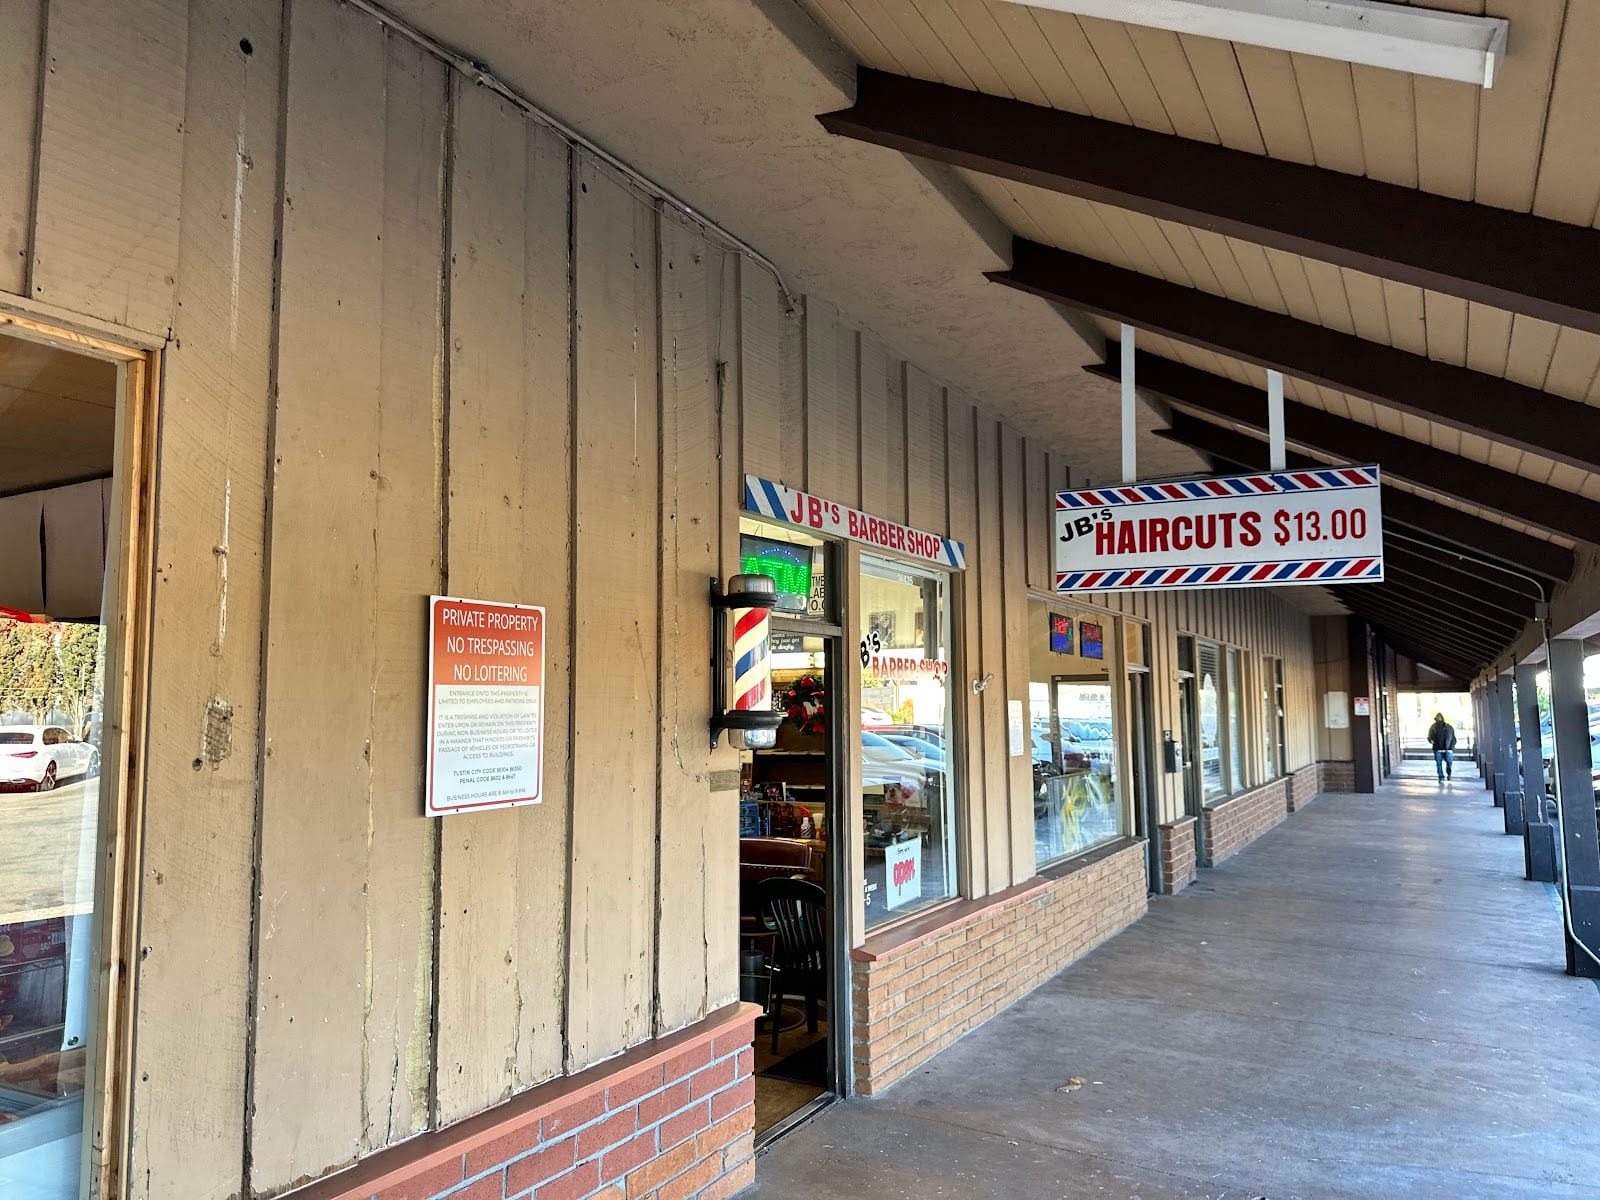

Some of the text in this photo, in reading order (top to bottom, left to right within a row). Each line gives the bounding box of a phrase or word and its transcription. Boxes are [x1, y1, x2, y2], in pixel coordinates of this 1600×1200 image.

[1095, 508, 1366, 556] HAIRCUTS $13.00
[744, 557, 808, 597] ATM
[443, 608, 538, 632] PRIVATE PROPERTY
[447, 636, 534, 657] NO TRESPASSING
[454, 664, 528, 682] NO LOITERING
